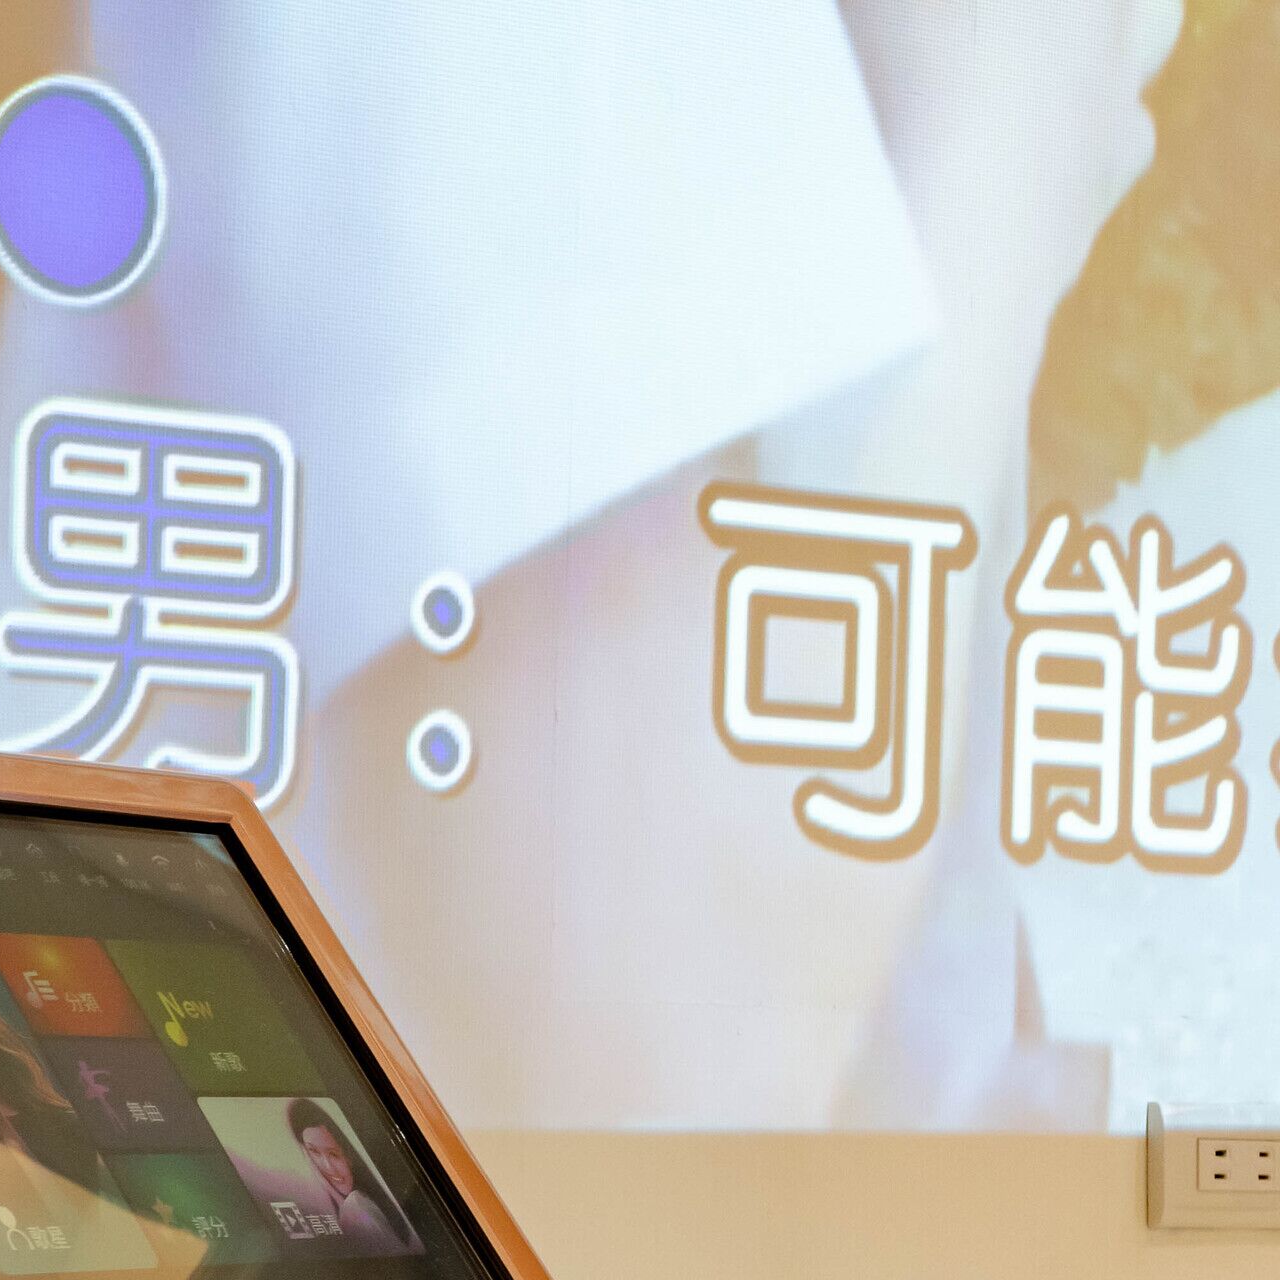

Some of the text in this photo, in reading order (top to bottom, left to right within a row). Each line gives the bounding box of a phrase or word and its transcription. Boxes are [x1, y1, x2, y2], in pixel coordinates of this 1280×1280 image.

[702, 482, 1280, 876] 可能
[64, 991, 101, 1013] 分類
[156, 990, 213, 1021] New
[126, 1101, 165, 1124] 舞曲
[28, 1225, 71, 1250] 歌星
[191, 1215, 229, 1240] 評分
[305, 1214, 343, 1236] 高清
